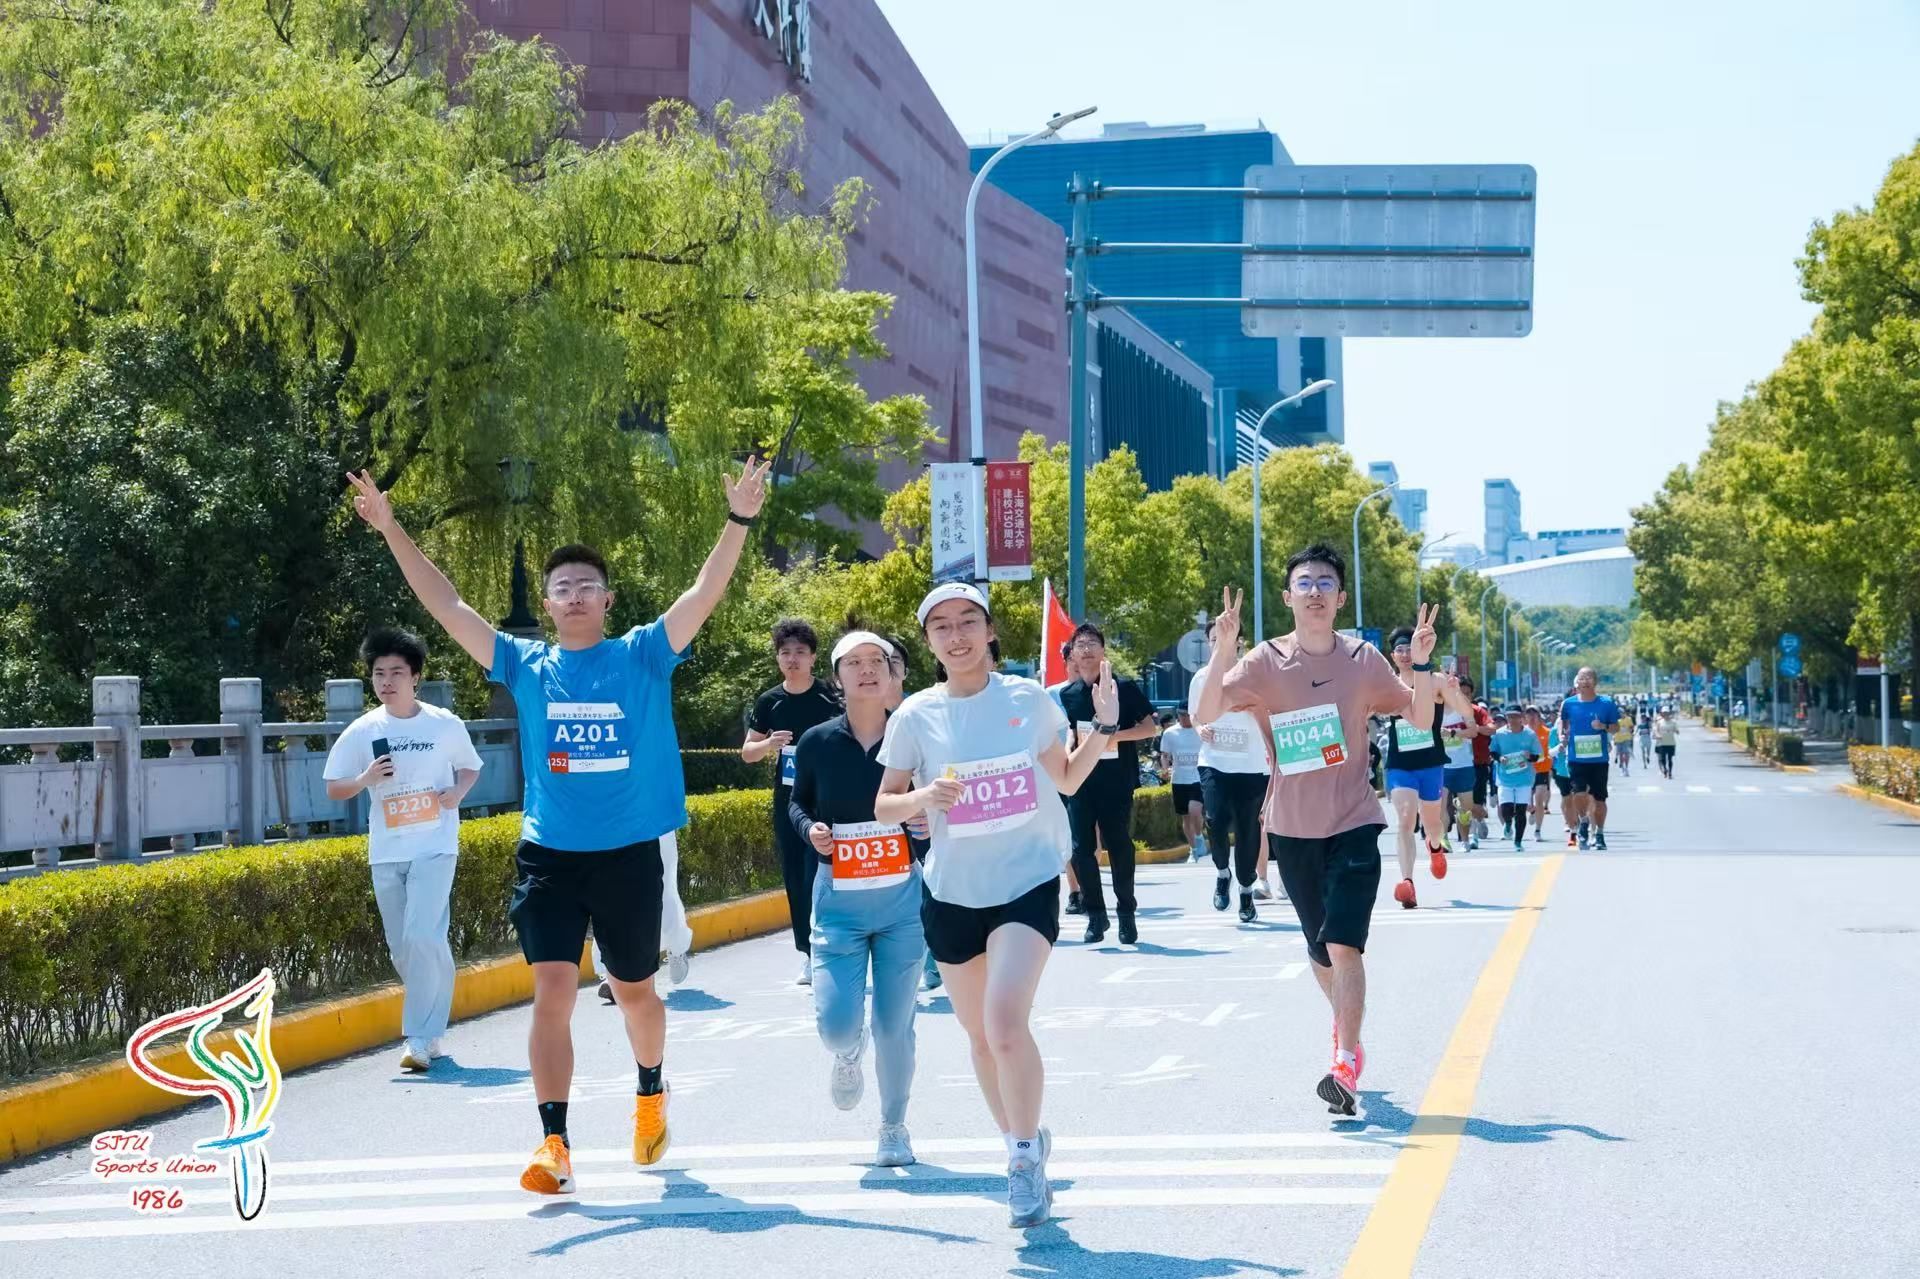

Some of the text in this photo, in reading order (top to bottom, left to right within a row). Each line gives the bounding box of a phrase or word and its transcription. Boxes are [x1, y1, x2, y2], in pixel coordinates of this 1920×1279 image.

[1003, 488, 1014, 549] 建校130周年
[1014, 488, 1025, 549] 上海交通大学
[554, 724, 618, 742] A201
[1278, 722, 1335, 749] H044
[551, 758, 567, 767] 252
[1325, 748, 1341, 760] 107
[953, 775, 1029, 806] M012
[388, 795, 432, 815] B220
[838, 839, 900, 862] D033
